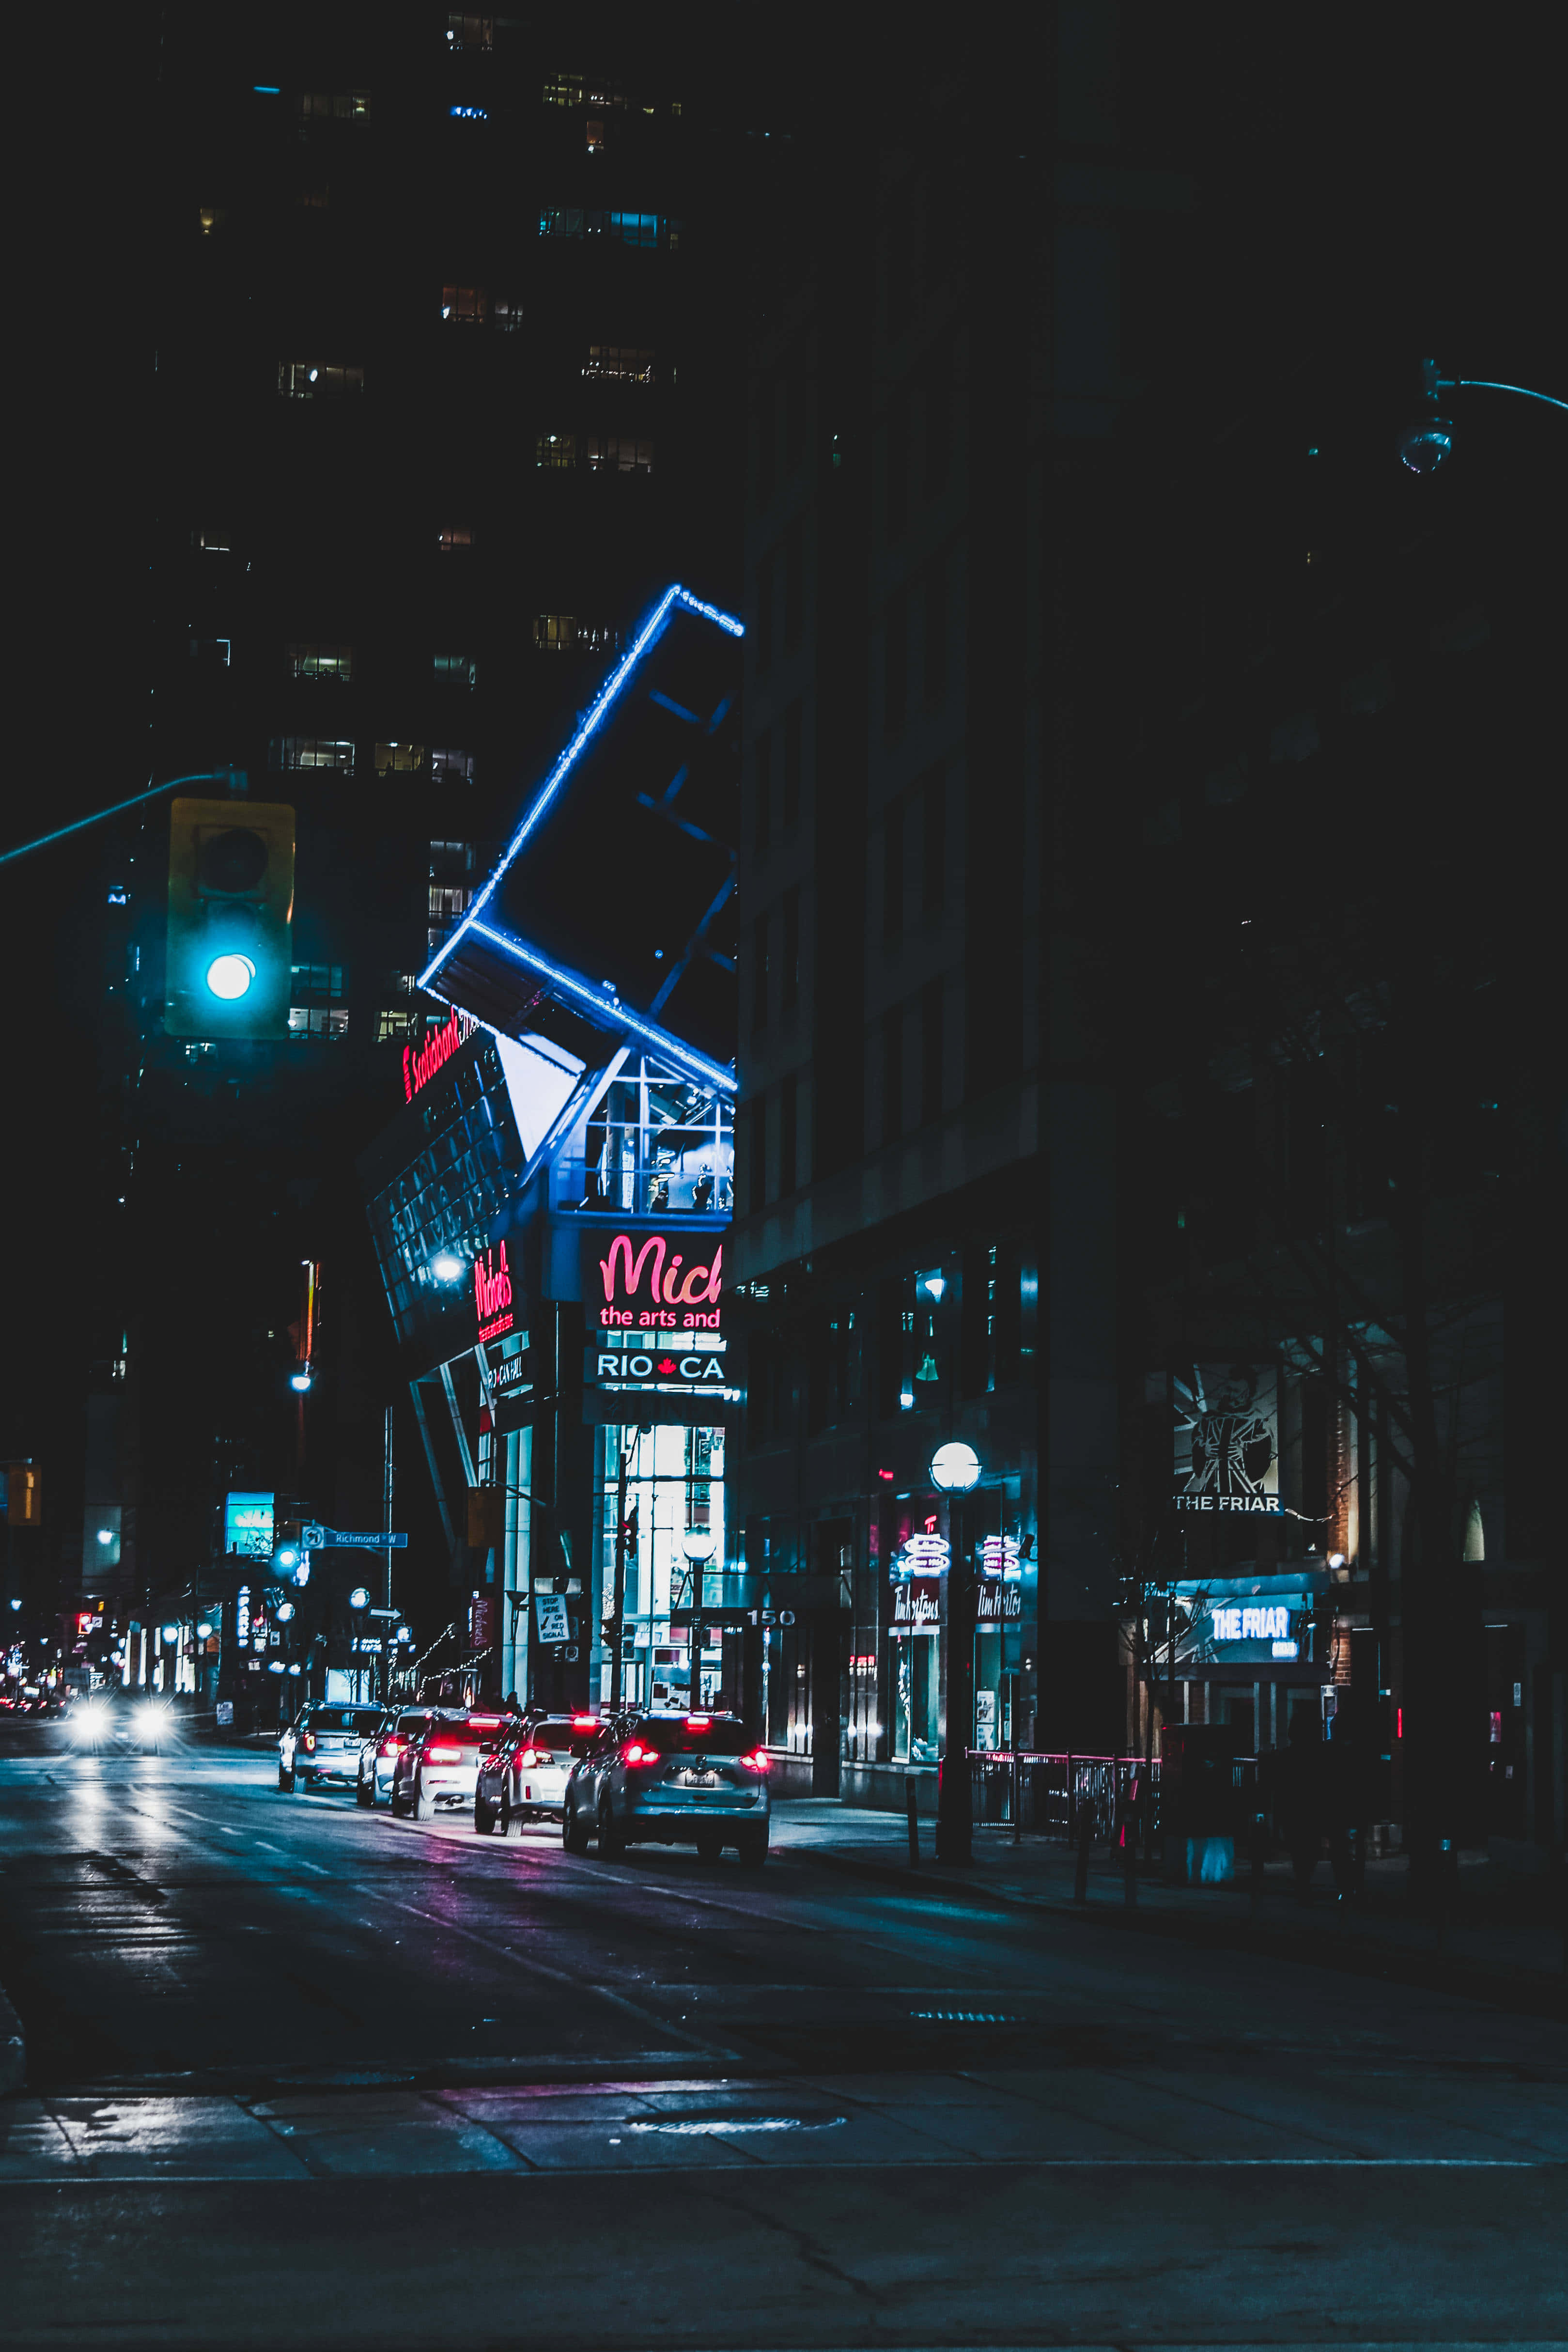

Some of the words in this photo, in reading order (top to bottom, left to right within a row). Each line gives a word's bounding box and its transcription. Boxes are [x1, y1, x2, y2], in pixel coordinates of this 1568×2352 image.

[413, 1005, 460, 1093] Scotiabank
[600, 1305, 633, 1326] the
[639, 1309, 677, 1327] arts
[683, 1308, 720, 1328] and
[597, 1354, 653, 1377] RIO
[1173, 1496, 1213, 1510] THE
[1219, 1496, 1280, 1511] FRIAR
[336, 1534, 380, 1543] Richmond
[388, 1534, 396, 1543] W
[542, 1597, 559, 1605] STOP
[543, 1605, 559, 1614] HERE
[747, 1609, 795, 1625] 150
[1211, 1608, 1242, 1640] THE
[1242, 1606, 1289, 1639] FRIAR
[543, 1631, 566, 1640] SIGNAL
